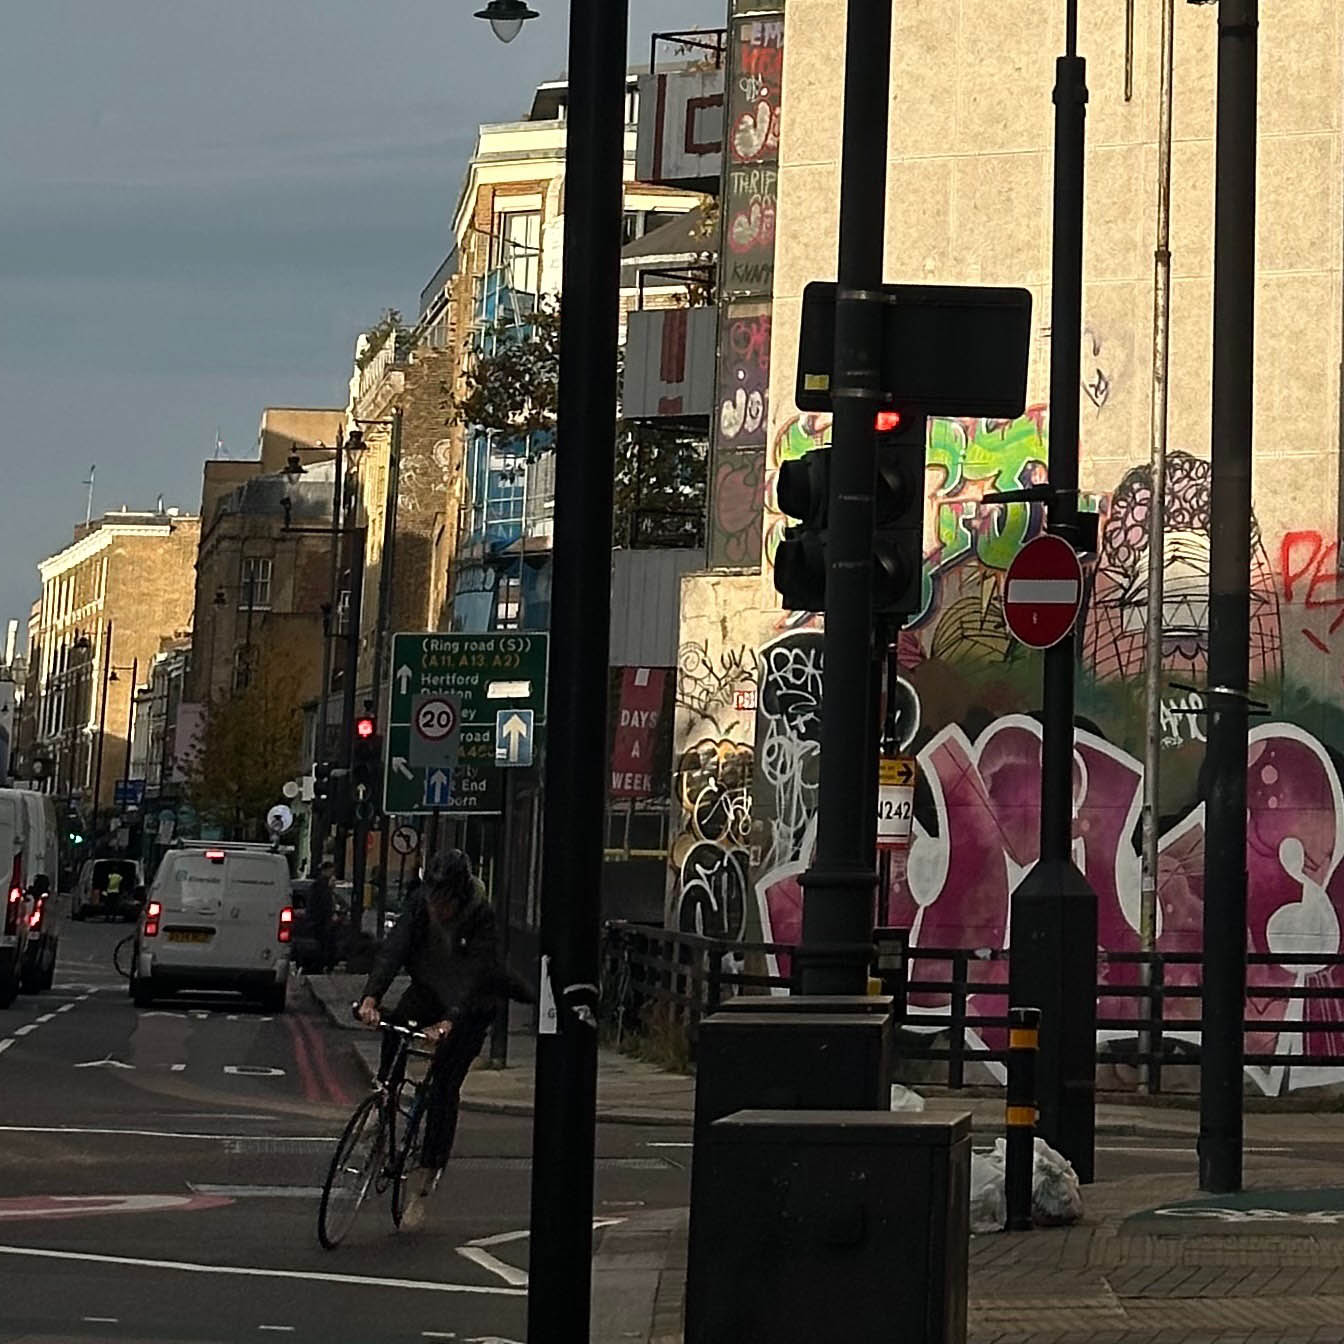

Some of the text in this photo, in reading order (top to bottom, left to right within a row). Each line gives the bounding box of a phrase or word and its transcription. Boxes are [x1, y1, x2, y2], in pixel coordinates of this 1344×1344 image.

[422, 638, 531, 653] (Ring road (S))
[421, 673, 479, 685] Hertford
[422, 711, 450, 728] 20
[620, 710, 657, 729] DAYS
[460, 731, 490, 742] road
[631, 740, 640, 758] A
[462, 780, 487, 791] End
[612, 772, 651, 791] WEEK
